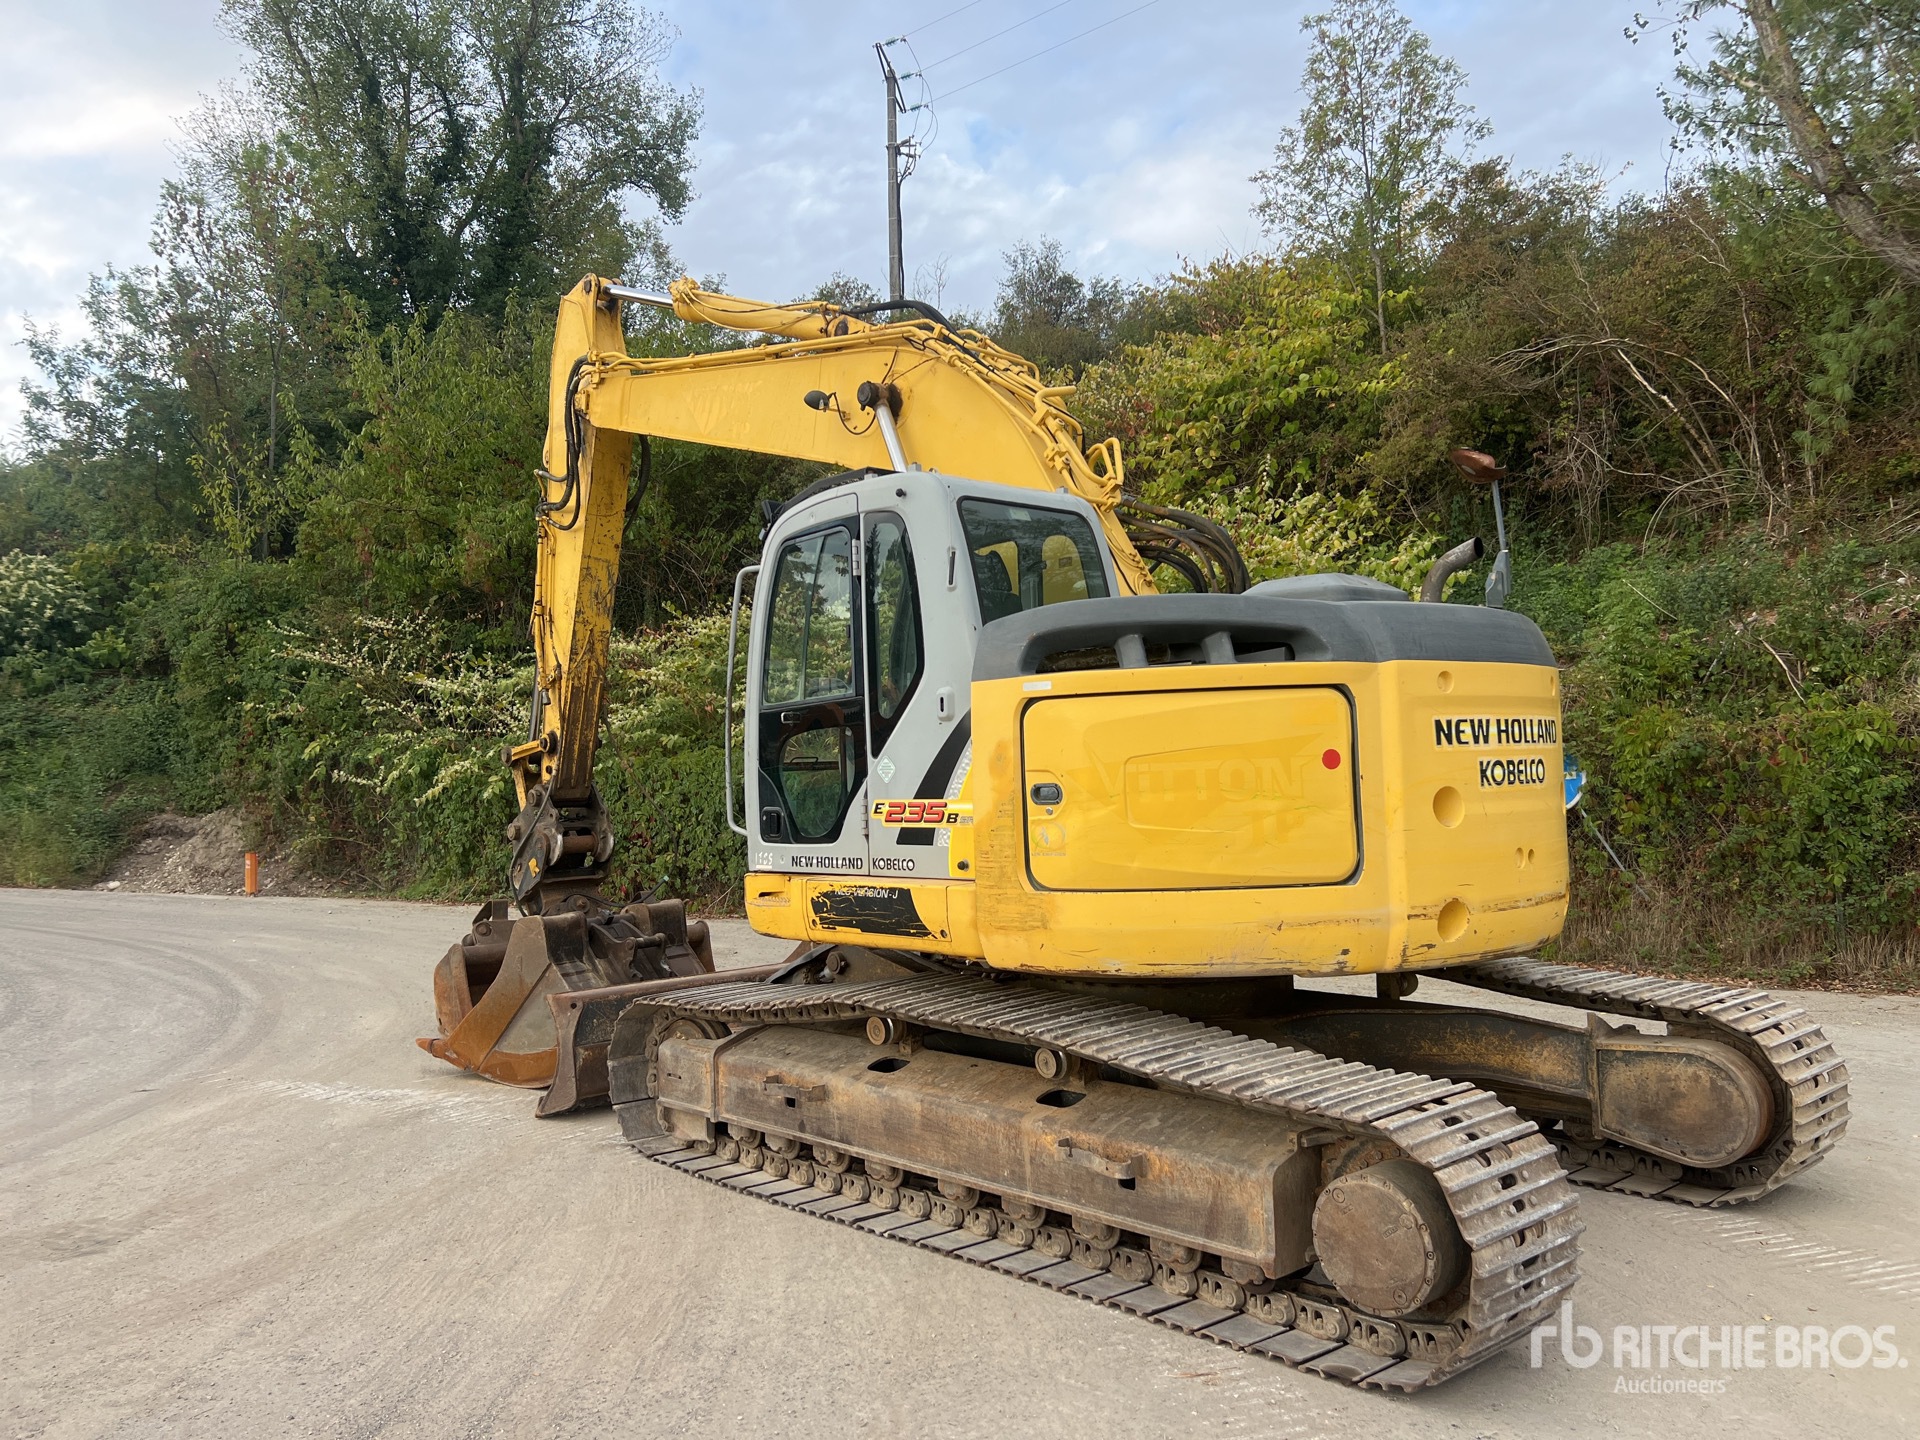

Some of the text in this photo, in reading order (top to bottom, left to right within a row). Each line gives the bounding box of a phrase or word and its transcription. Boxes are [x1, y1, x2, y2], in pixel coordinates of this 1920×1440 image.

[1434, 718, 1557, 746] NEW HOLLAND
[1479, 758, 1546, 787] KOBELCO
[791, 855, 916, 872] NEW HOLLAND KOBELCO
